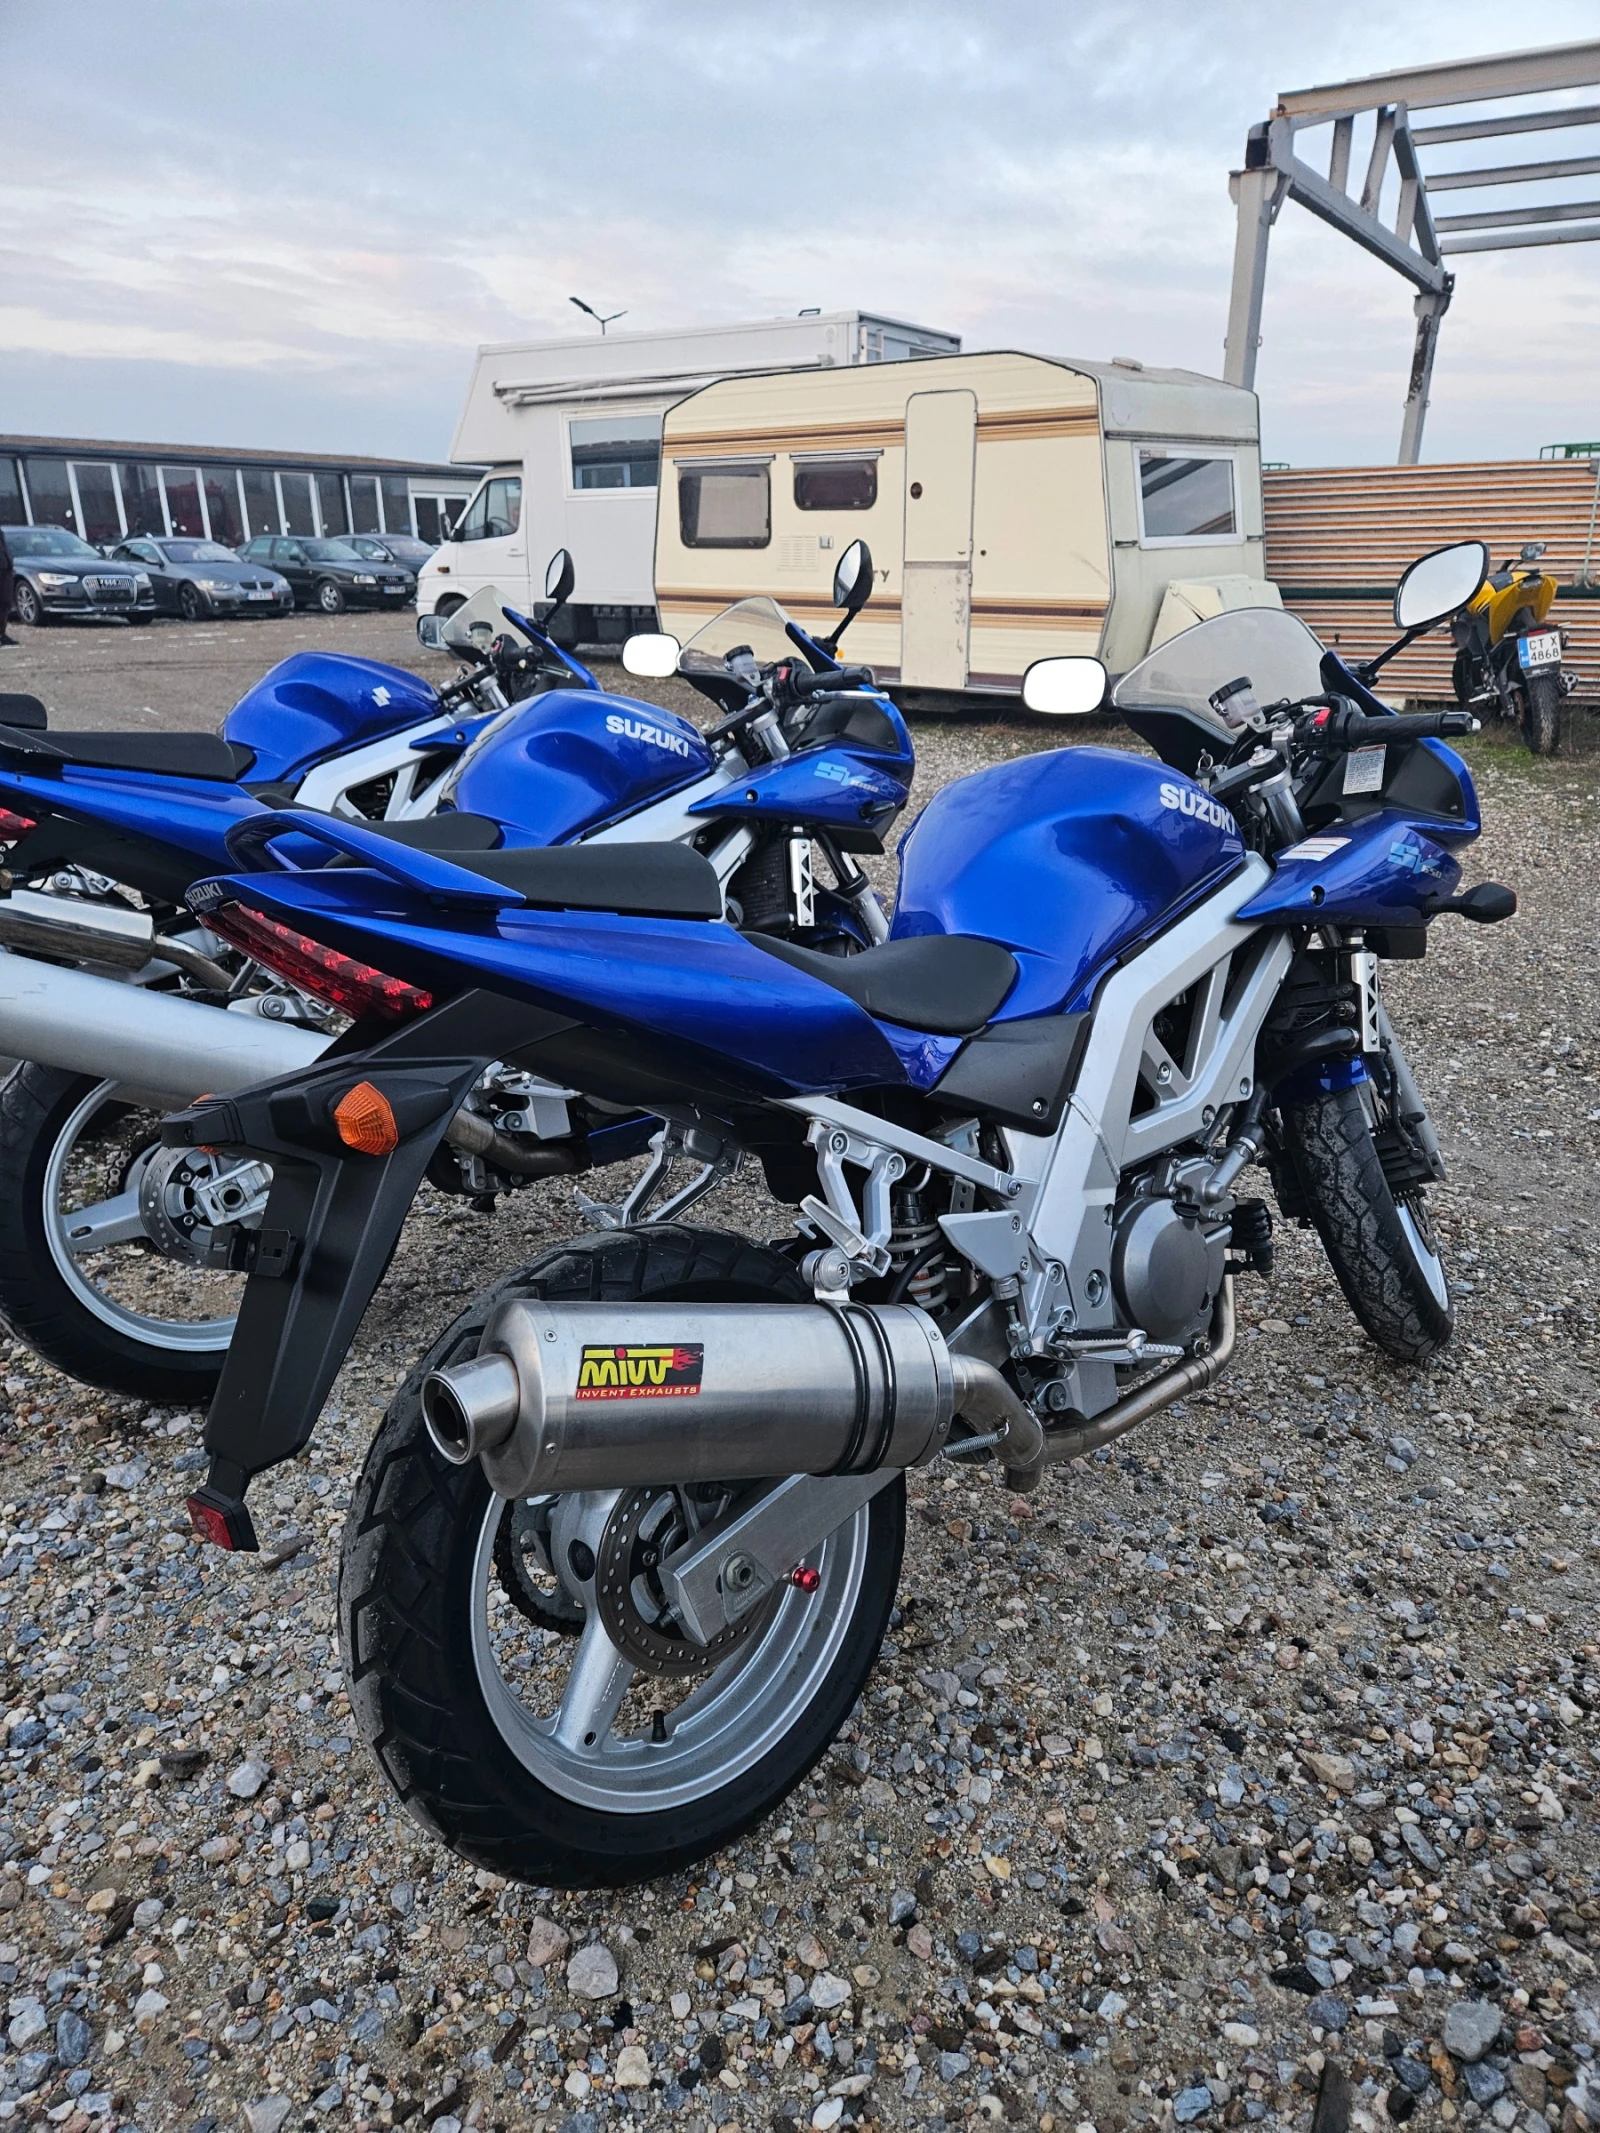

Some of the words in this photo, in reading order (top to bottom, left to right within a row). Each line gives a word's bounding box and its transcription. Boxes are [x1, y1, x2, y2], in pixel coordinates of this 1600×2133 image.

[1529, 638, 1544, 650] CT
[1530, 647, 1560, 661] 4868
[606, 715, 689, 758] SUZUKI
[1160, 783, 1236, 836] SUZUKI
[185, 882, 224, 907] SUZUKI
[577, 1389, 626, 1398] INVENT
[629, 1386, 697, 1397] EXHAUSTS
